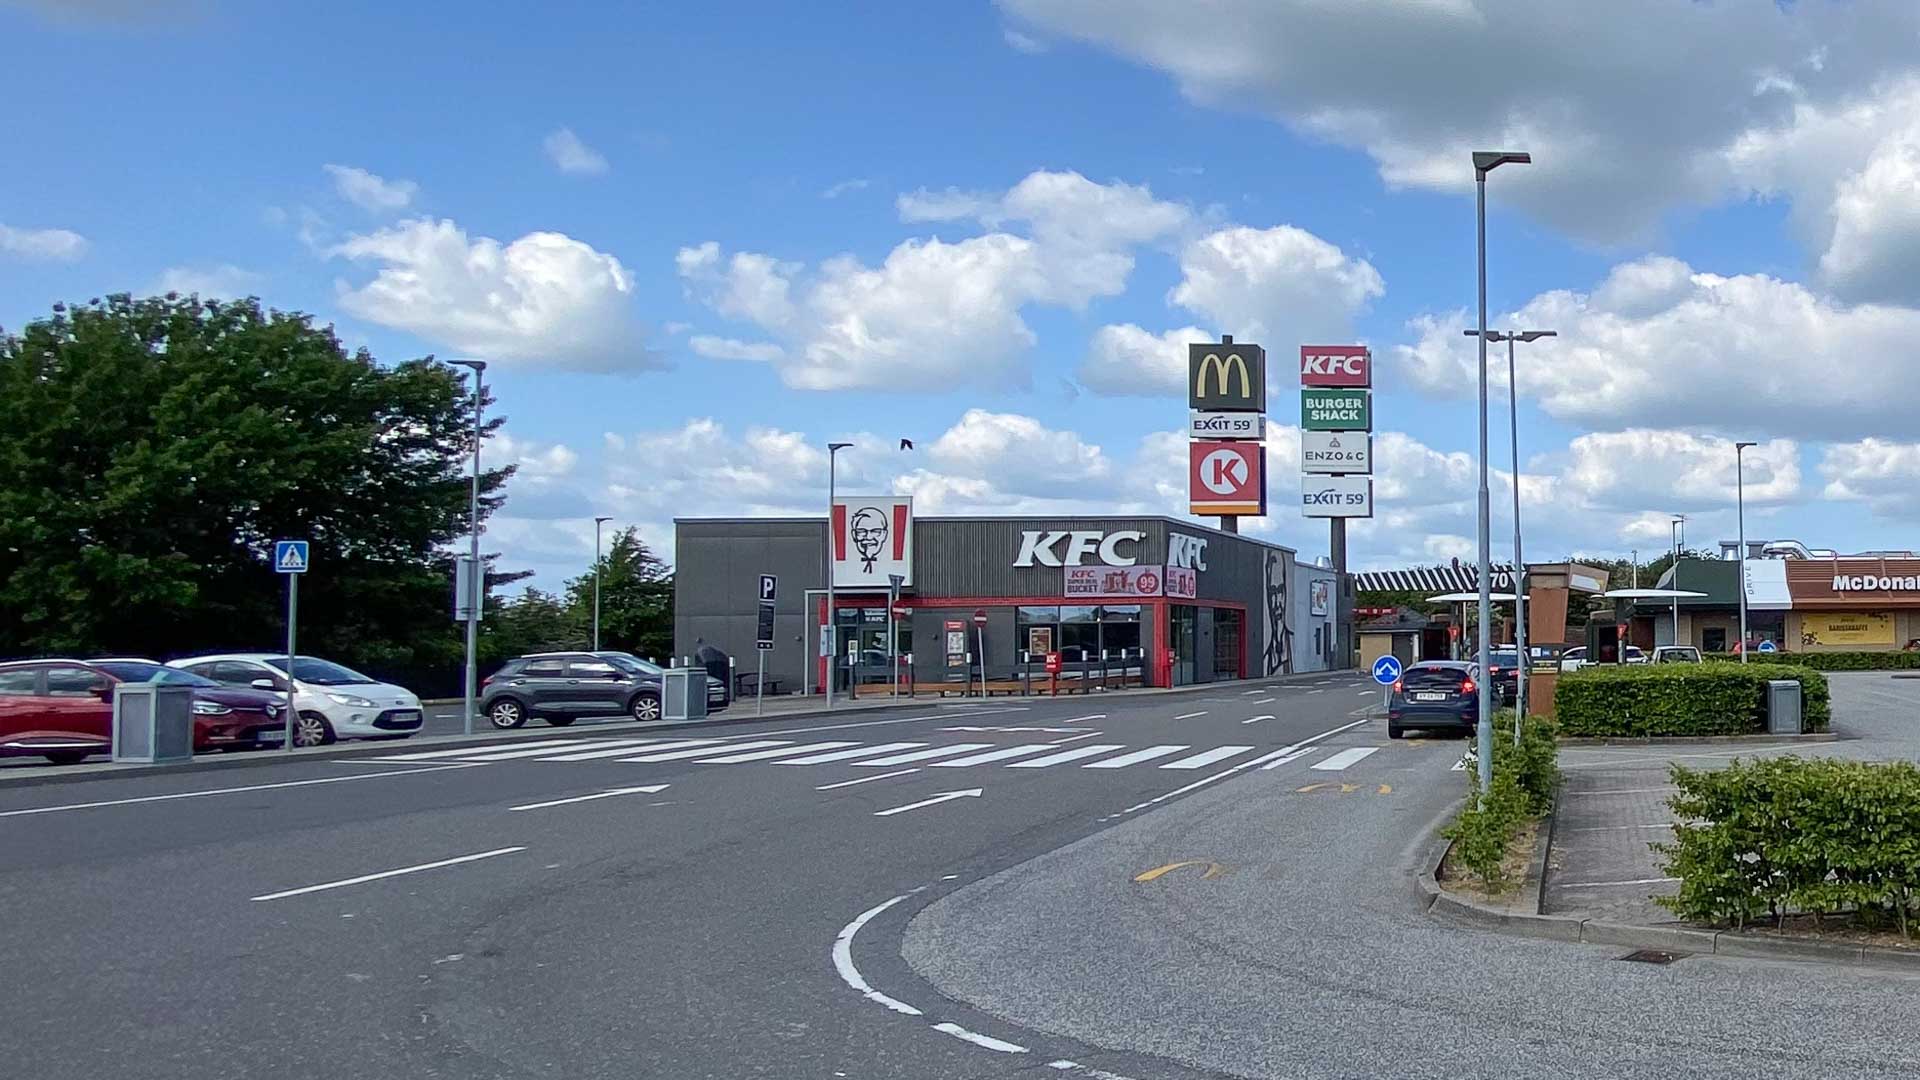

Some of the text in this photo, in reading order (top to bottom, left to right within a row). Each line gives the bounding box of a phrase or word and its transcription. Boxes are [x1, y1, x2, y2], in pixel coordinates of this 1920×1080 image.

[1302, 355, 1364, 375] KFC
[1305, 398, 1363, 409] BURGER
[1311, 410, 1359, 420] SHACK
[1233, 421, 1250, 430] 59
[1305, 452, 1364, 461] ENZO & C
[1345, 494, 1364, 505] 59
[1013, 530, 1143, 567] KFC
[1168, 532, 1207, 571] KFC
[1071, 570, 1095, 578] KFC
[763, 578, 773, 597] P
[1140, 576, 1155, 588] 99
[1067, 585, 1098, 593] BUCKET
